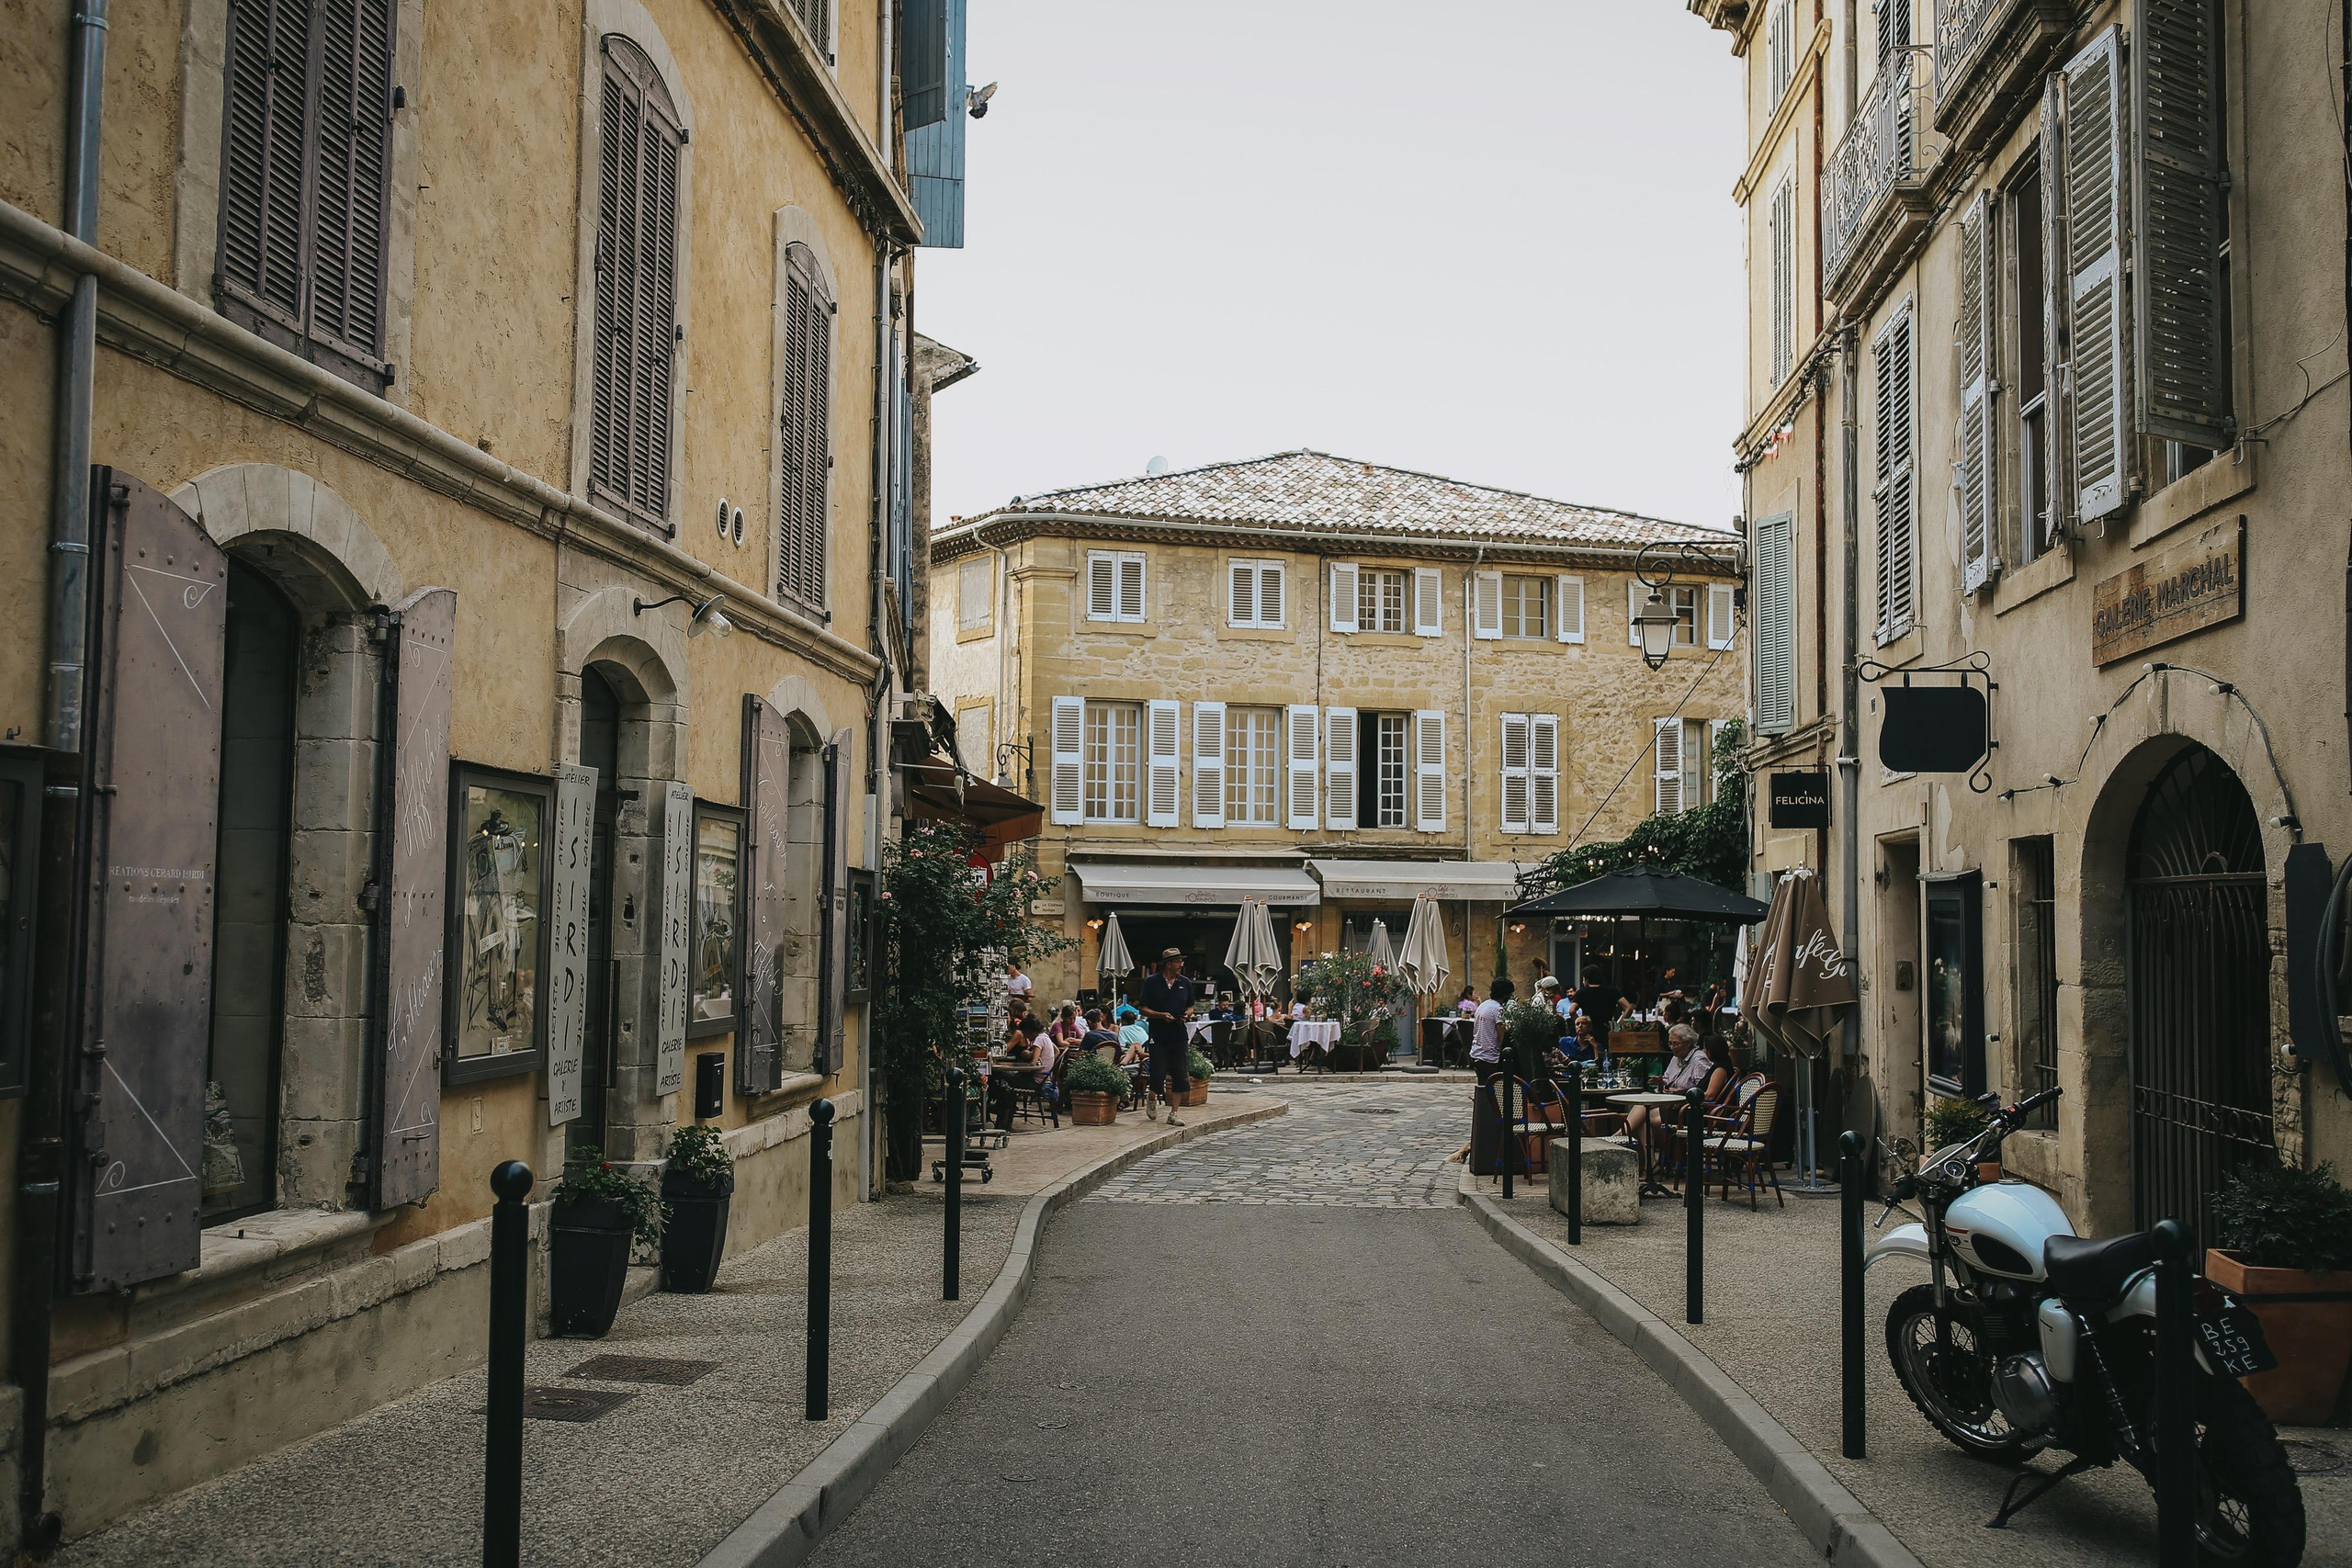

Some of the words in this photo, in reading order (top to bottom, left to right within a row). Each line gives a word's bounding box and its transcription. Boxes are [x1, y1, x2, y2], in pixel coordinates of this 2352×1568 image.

[2096, 588, 2151, 637] GALERIE
[2156, 553, 2233, 612] MARCHAL
[564, 773, 591, 786] ATELIER
[671, 790, 689, 802] ATELIER
[582, 801, 592, 867] GALERIE
[564, 797, 579, 1051] ISIRDI
[671, 810, 682, 1031] ISIRDI
[576, 973, 585, 1047] ARTISTE
[660, 1073, 681, 1089] ARTISTE
[554, 1099, 577, 1116] ARTISTE
[2201, 1317, 2234, 1340] BE
[2213, 1337, 2250, 1357] 259
[2223, 1354, 2257, 1373] KE
